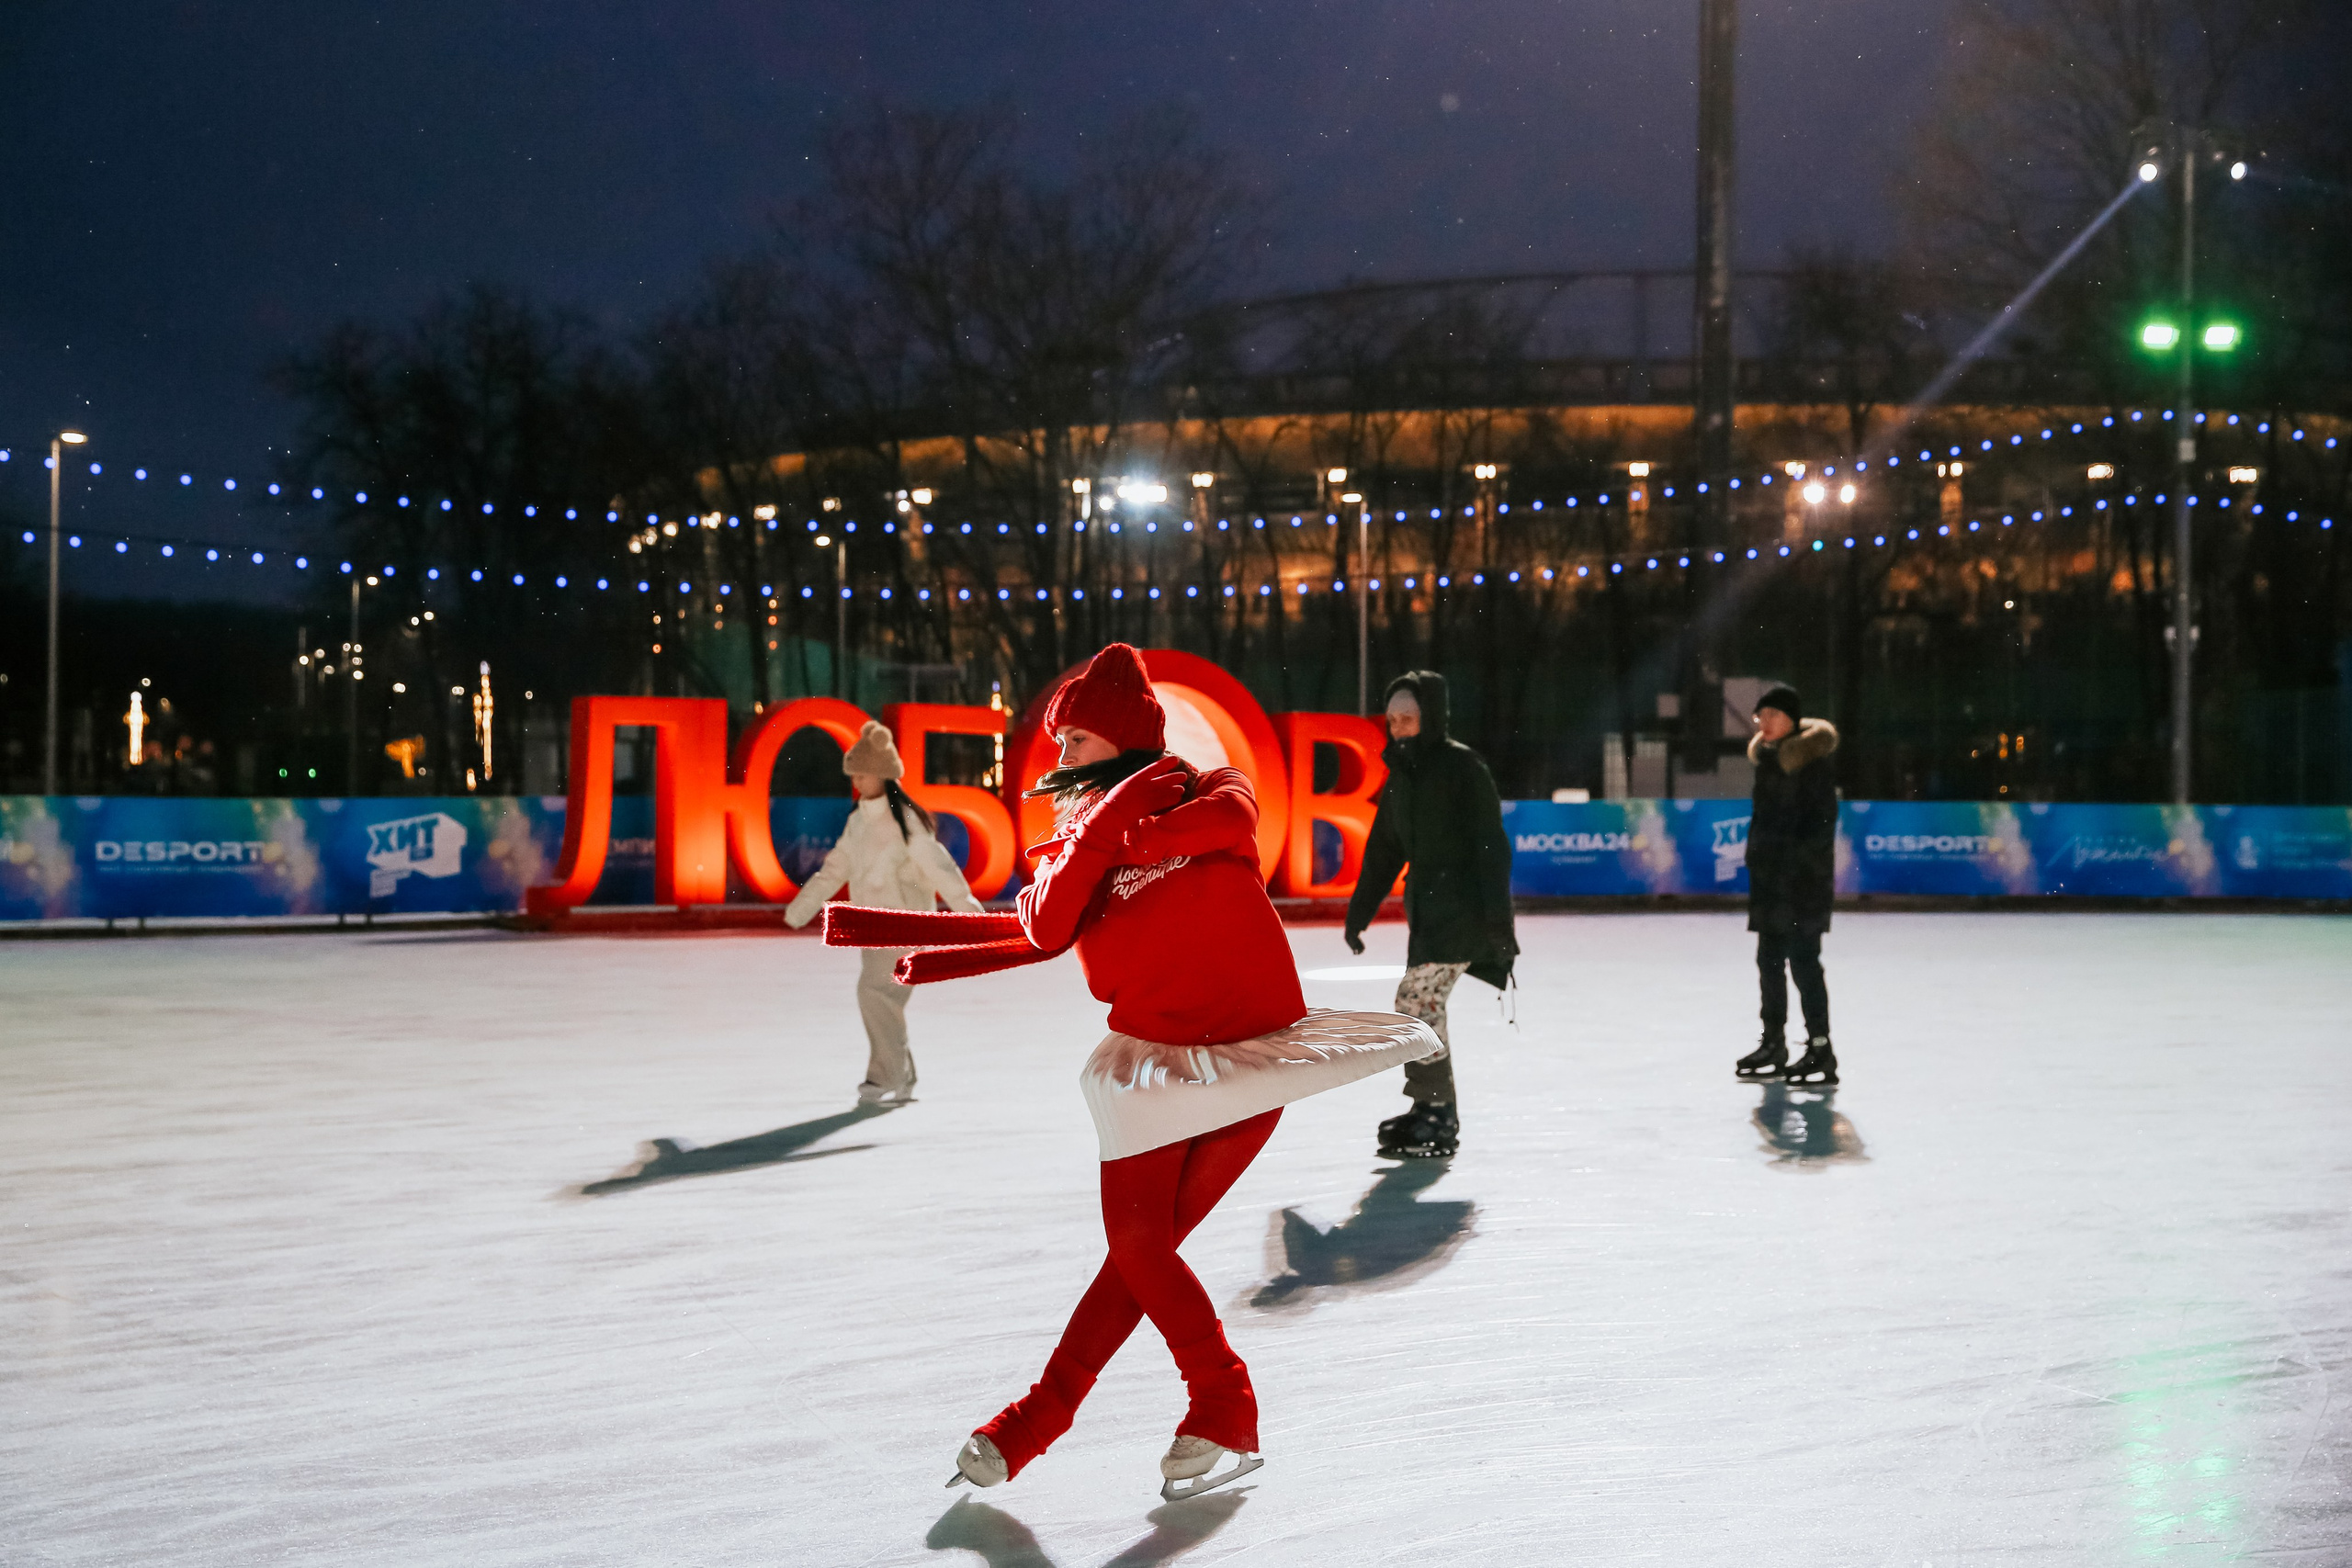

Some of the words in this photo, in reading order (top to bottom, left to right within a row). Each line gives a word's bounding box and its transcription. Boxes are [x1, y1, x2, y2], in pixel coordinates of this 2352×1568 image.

[372, 818, 439, 855] ХИТ
[1864, 834, 1989, 852] DESPORT
[95, 840, 264, 862] DESPORT
